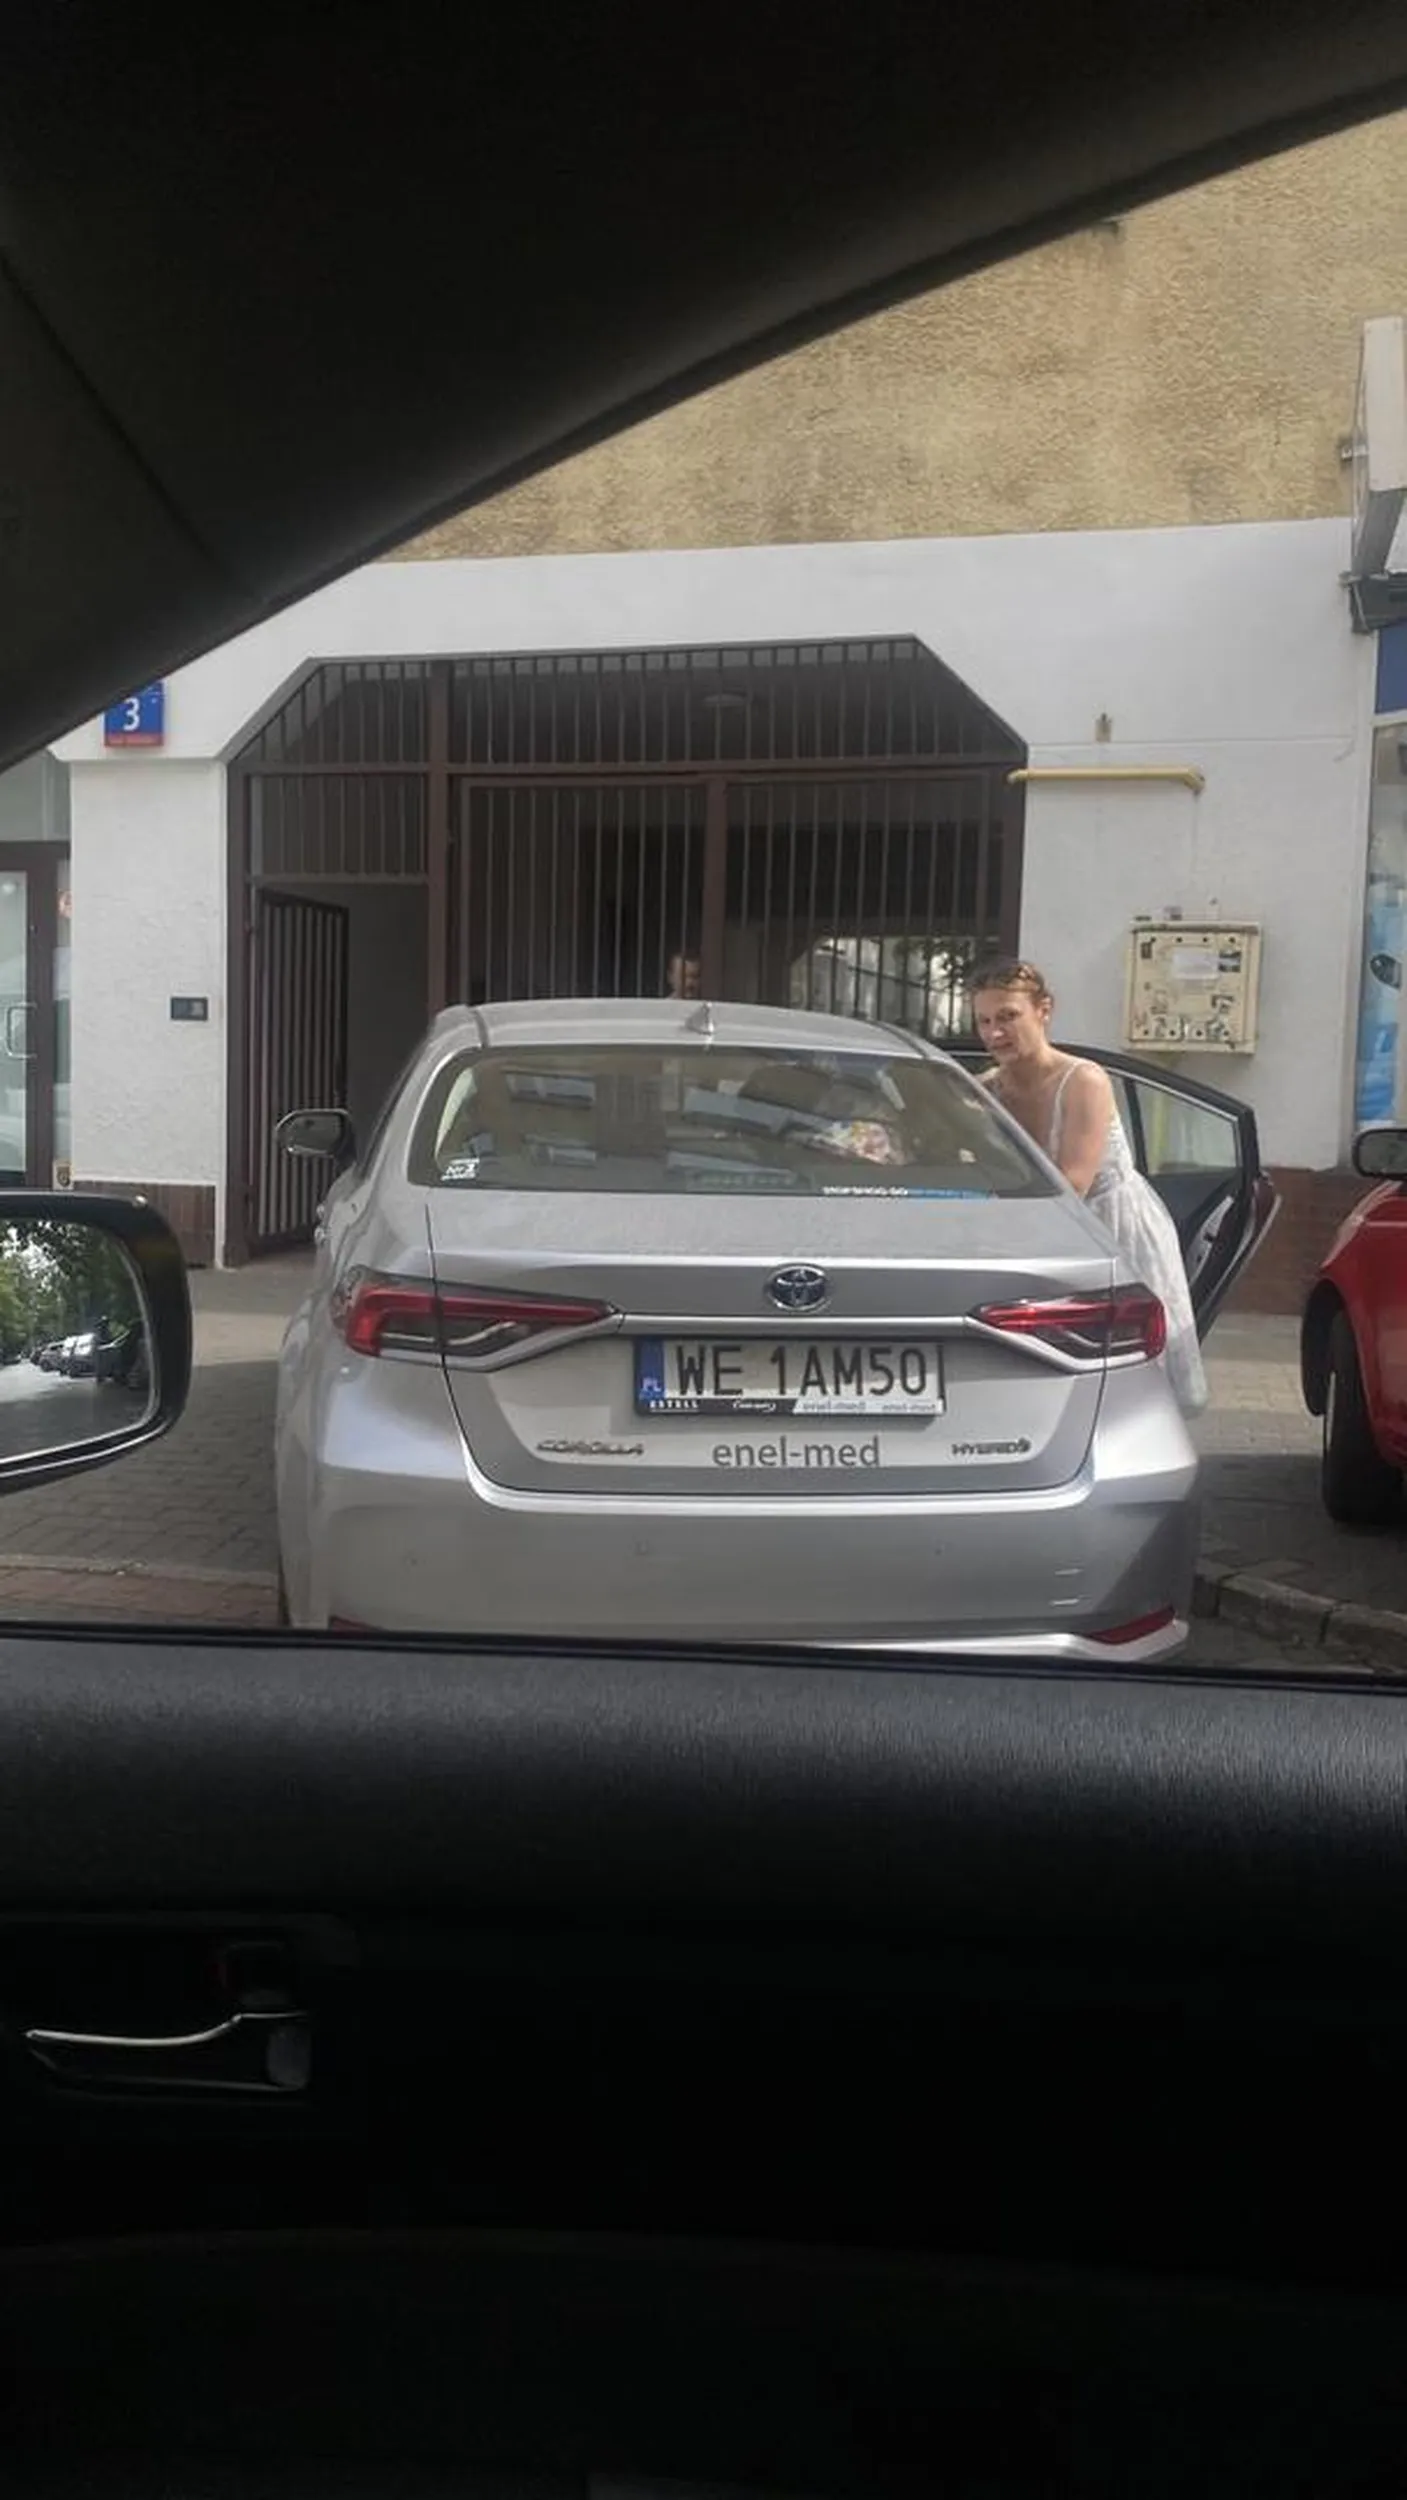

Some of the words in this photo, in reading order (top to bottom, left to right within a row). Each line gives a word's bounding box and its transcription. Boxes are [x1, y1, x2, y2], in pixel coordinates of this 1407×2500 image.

[123, 697, 140, 731] 3
[642, 1378, 662, 1393] PL
[675, 1345, 744, 1397] WE
[769, 1344, 927, 1397] 1AM50
[712, 1436, 880, 1468] enel-med
